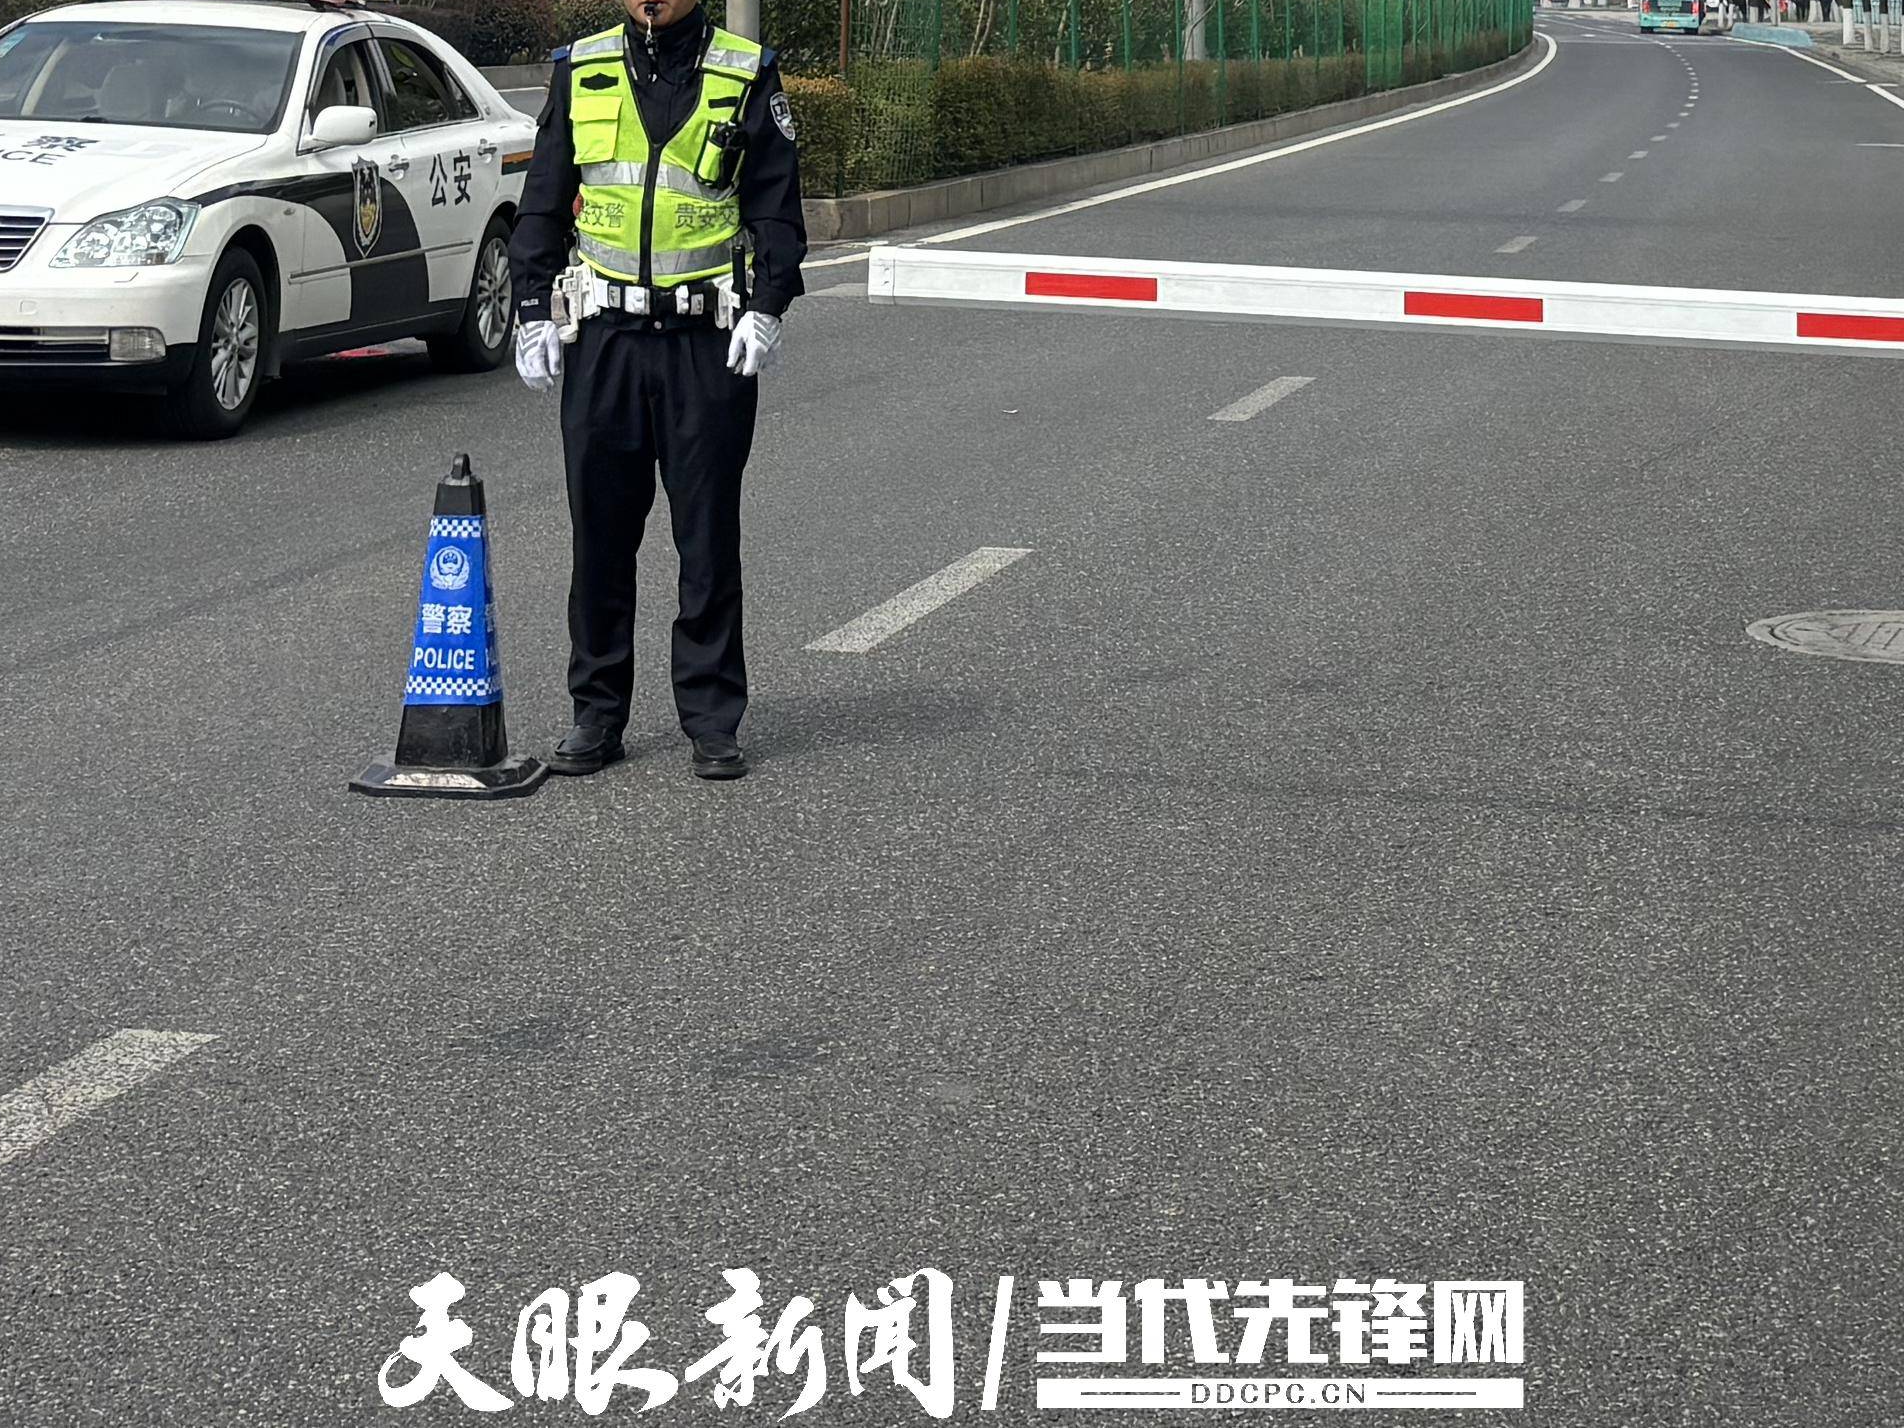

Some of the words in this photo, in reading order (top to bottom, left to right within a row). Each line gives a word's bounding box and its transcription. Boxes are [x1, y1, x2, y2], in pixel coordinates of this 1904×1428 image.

[429, 149, 472, 208] 公安
[421, 603, 473, 634] 警察
[413, 646, 476, 670] POLICE
